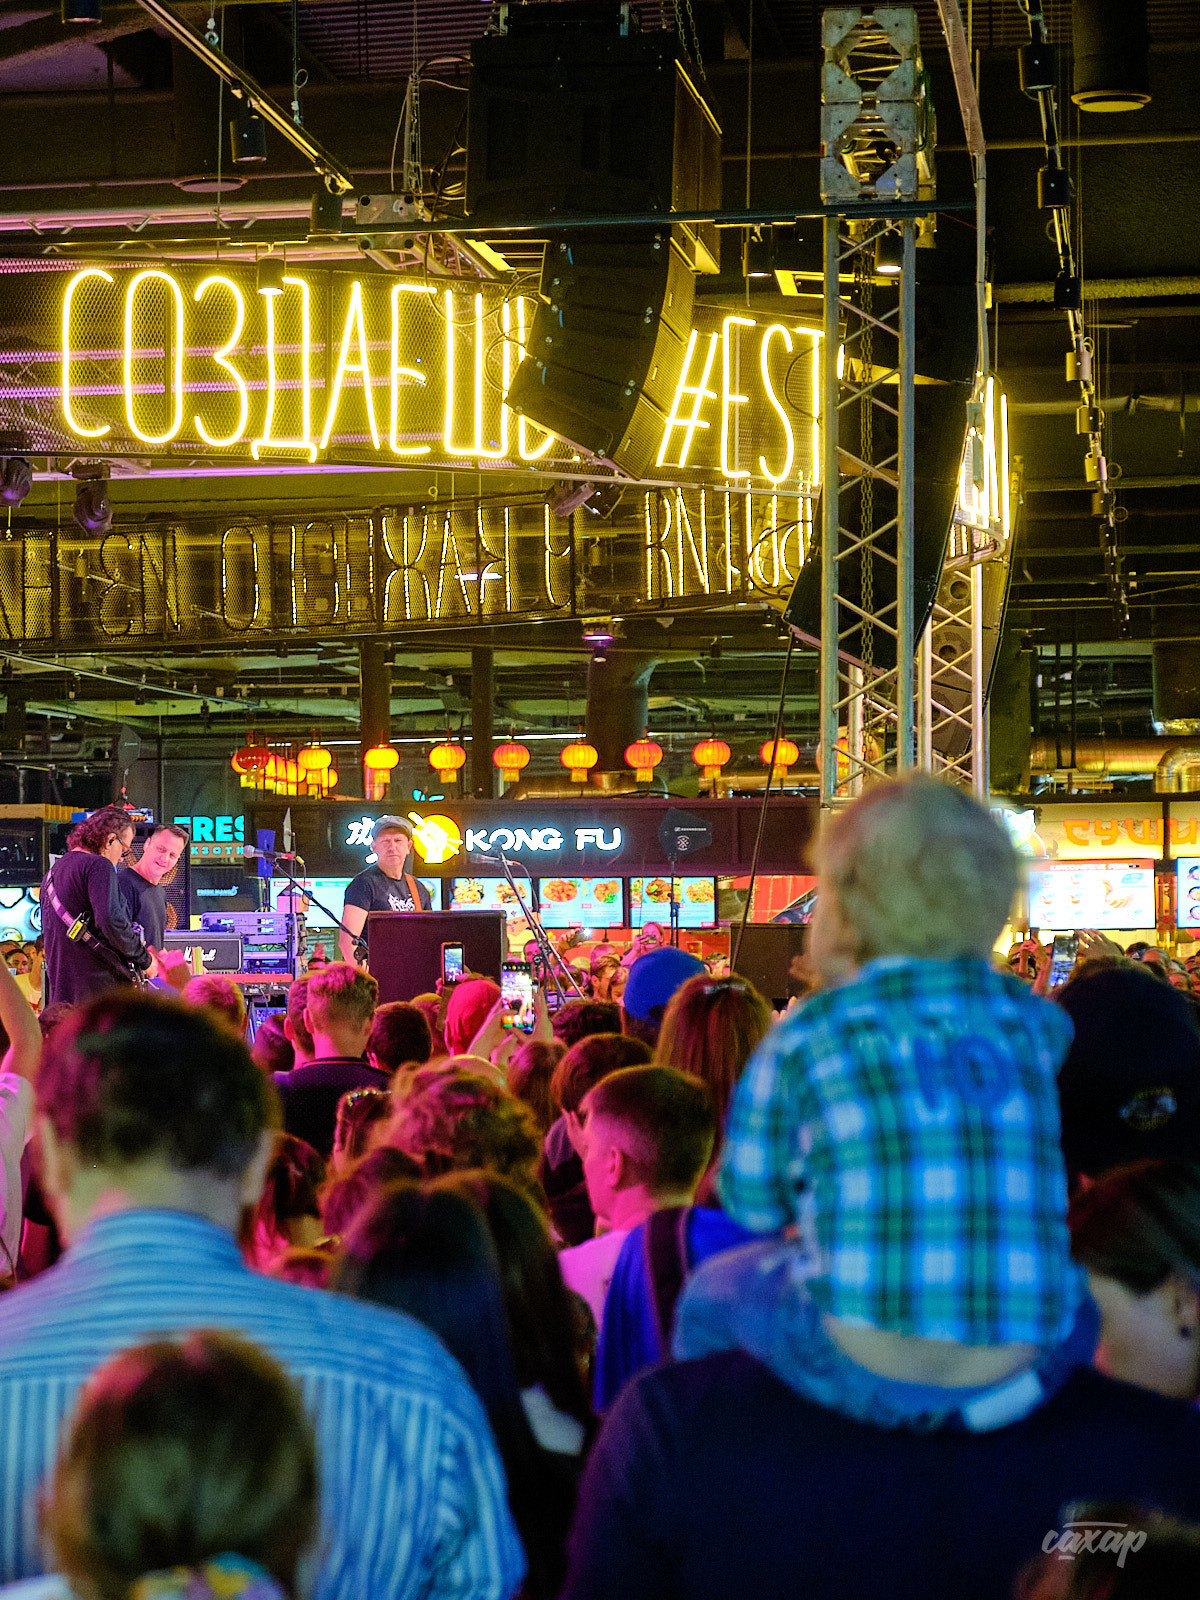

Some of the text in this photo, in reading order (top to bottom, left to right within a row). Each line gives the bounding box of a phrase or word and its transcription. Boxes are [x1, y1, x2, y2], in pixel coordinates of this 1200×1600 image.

[655, 314, 844, 486] #EST
[465, 827, 622, 851] KONG FU
[1062, 818, 1198, 847] СУШИ
